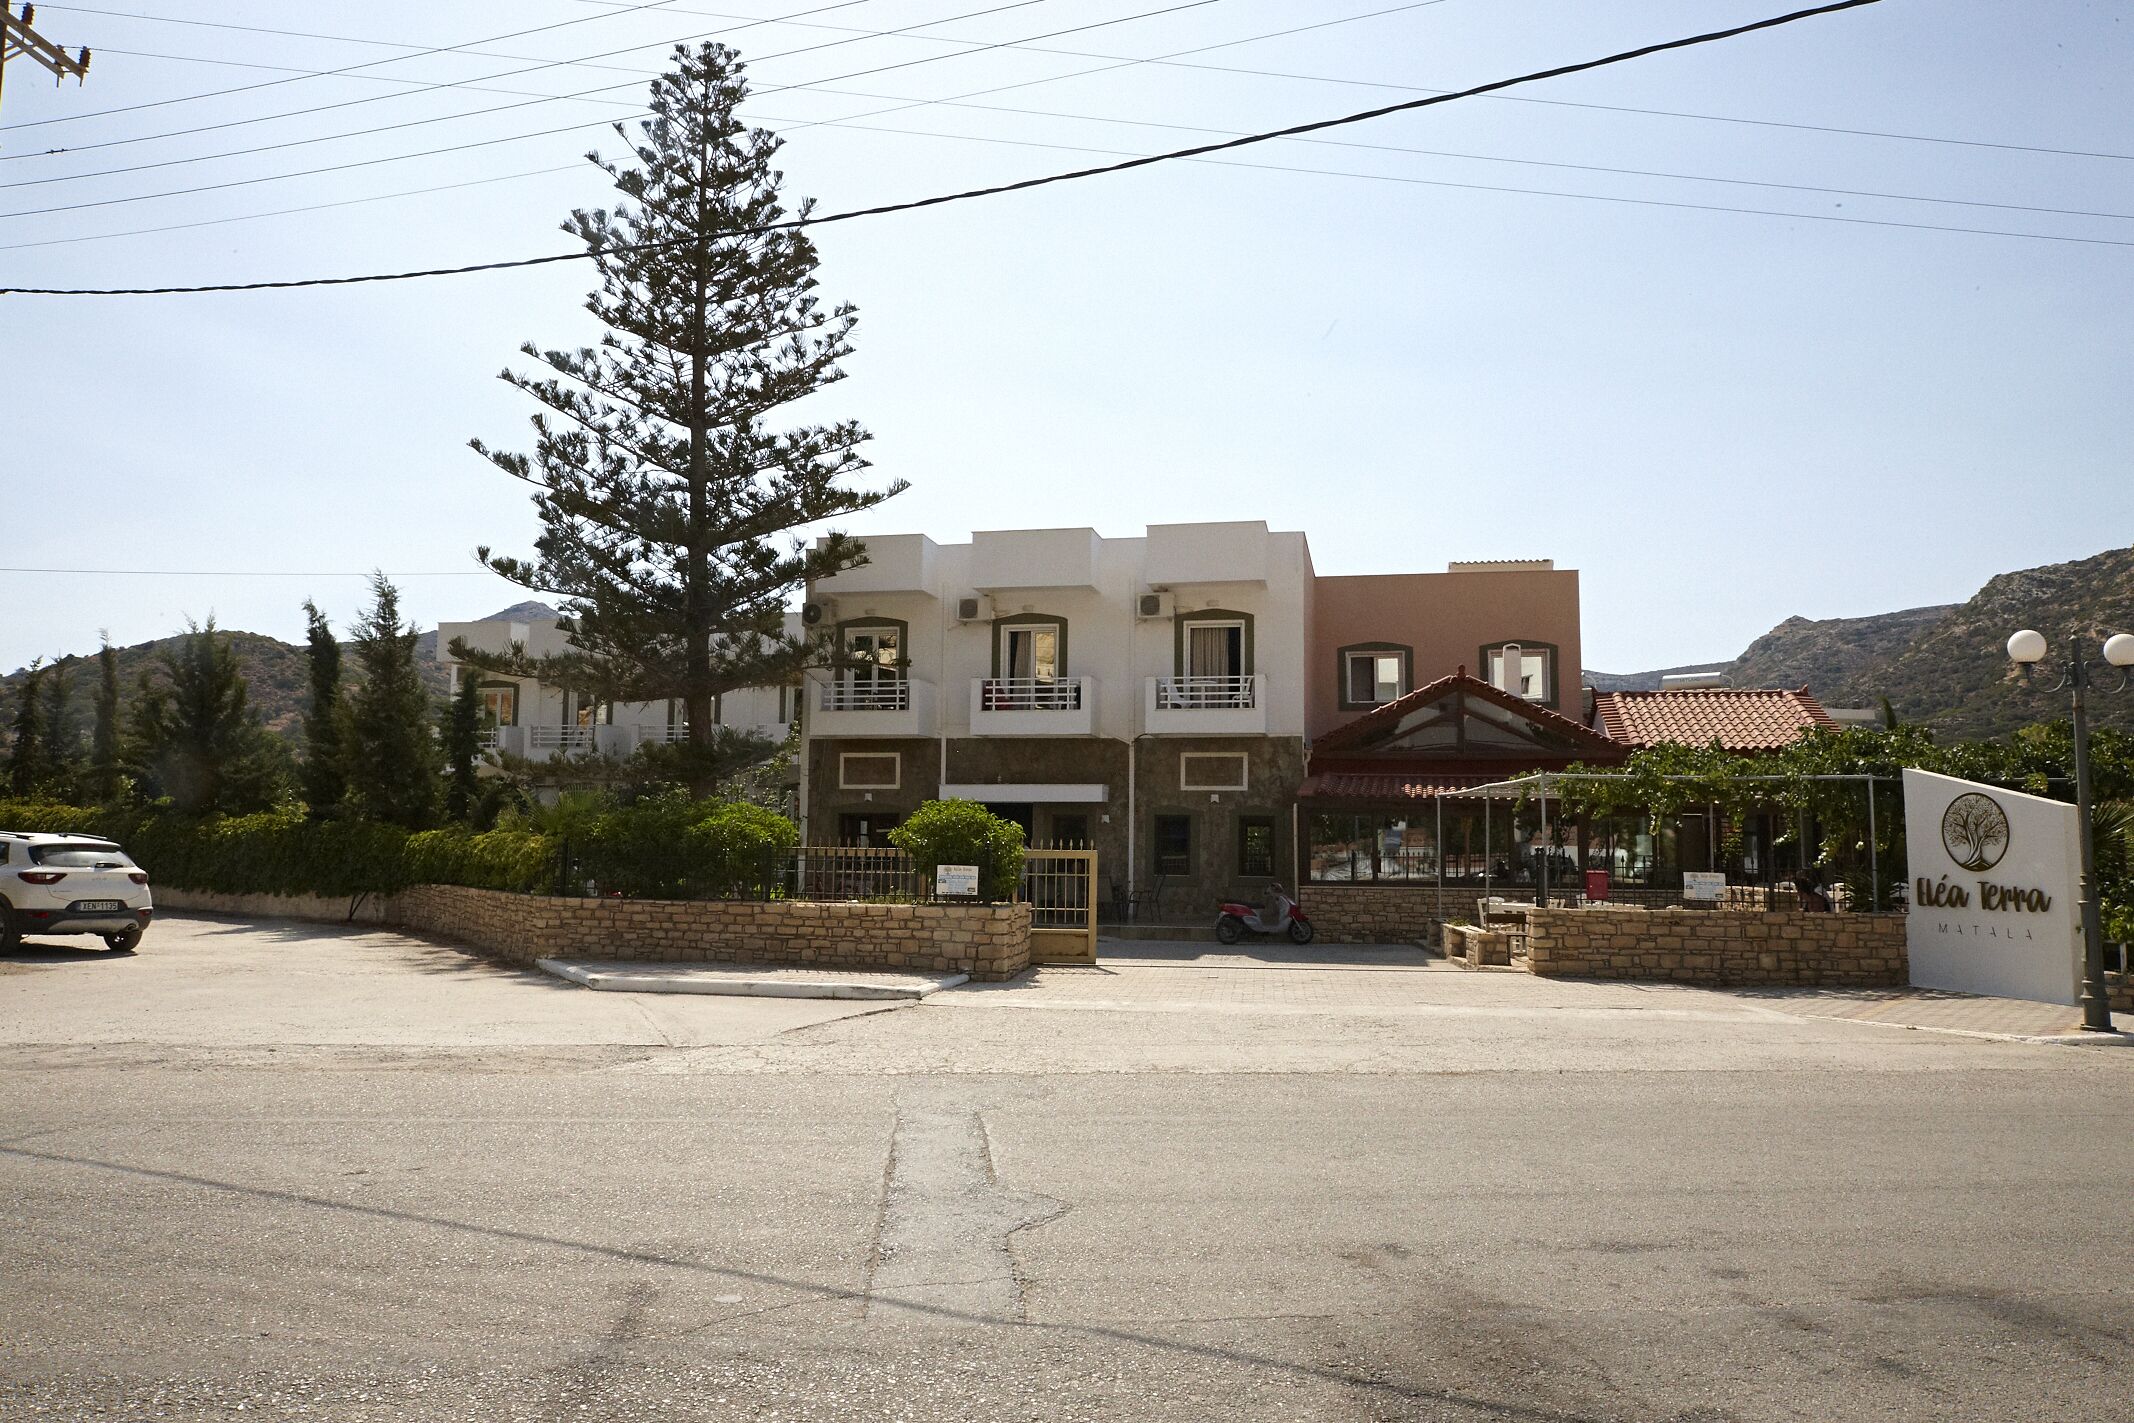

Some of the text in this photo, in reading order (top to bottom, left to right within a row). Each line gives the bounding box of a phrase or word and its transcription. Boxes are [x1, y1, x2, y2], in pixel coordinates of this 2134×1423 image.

[1916, 874, 2051, 912] Eléa Terra
[1938, 922, 2033, 941] MATALA
